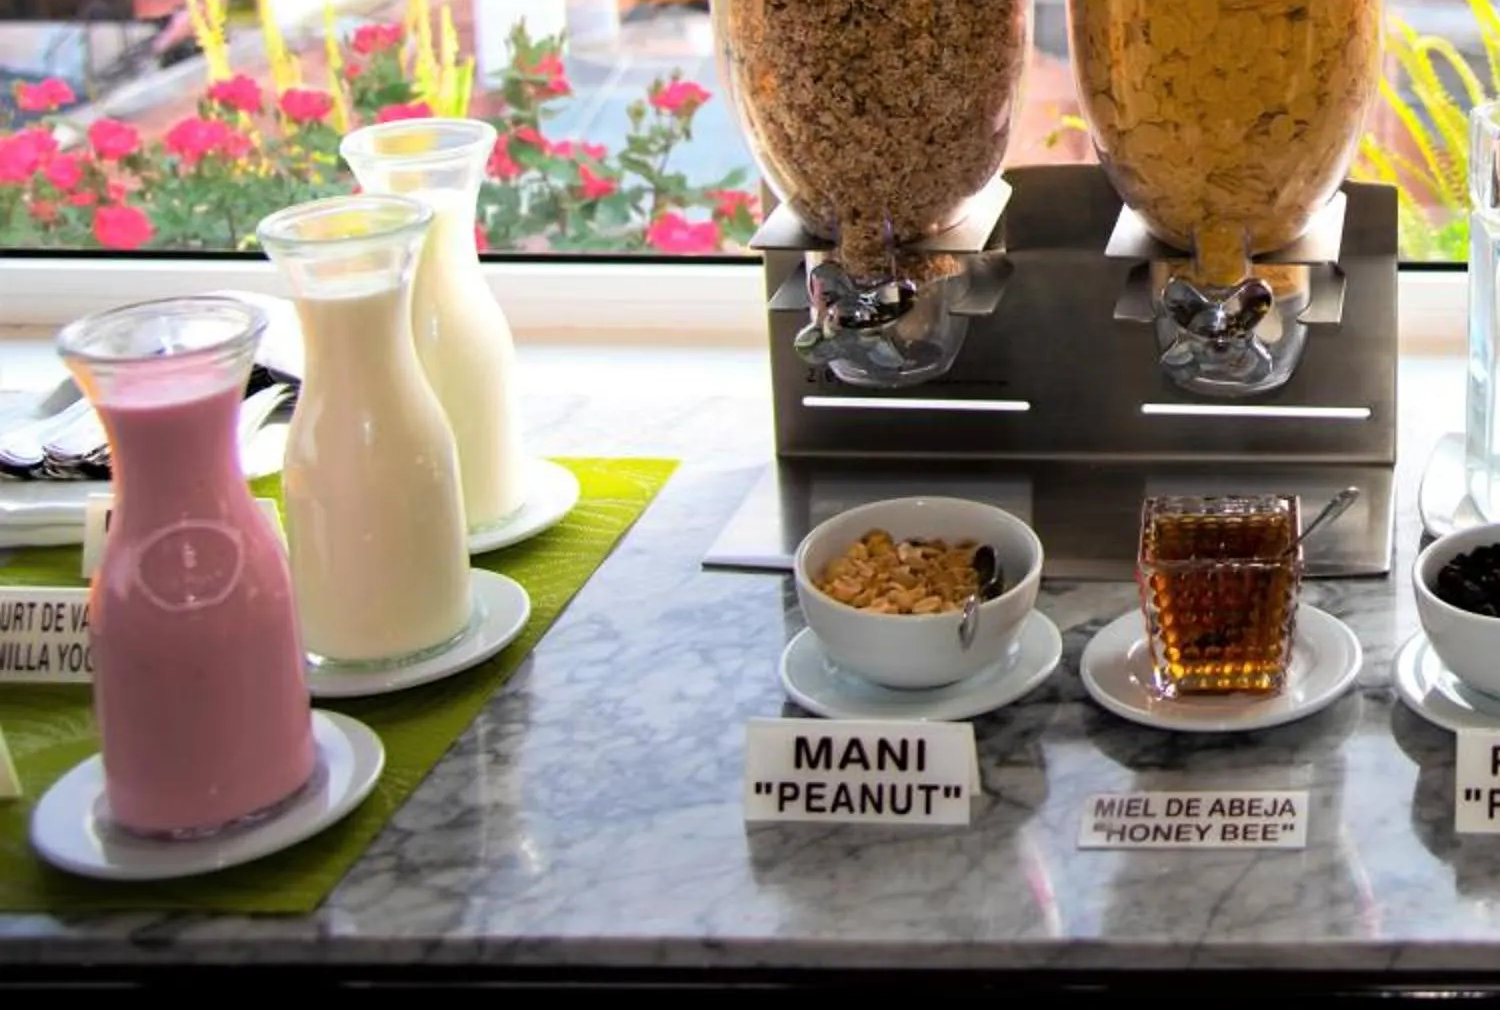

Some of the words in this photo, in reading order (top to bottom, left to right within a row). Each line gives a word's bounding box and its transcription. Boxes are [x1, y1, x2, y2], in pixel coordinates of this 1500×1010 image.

[41, 601, 66, 632] DE
[794, 735, 926, 772] MANI
[754, 781, 962, 815] "PEANUT"
[1093, 797, 1157, 818] MIEL
[1165, 797, 1201, 818] DE
[1207, 797, 1297, 818] ABEJA
[1092, 823, 1213, 843] "HONEY
[1220, 823, 1295, 842] BEE"
